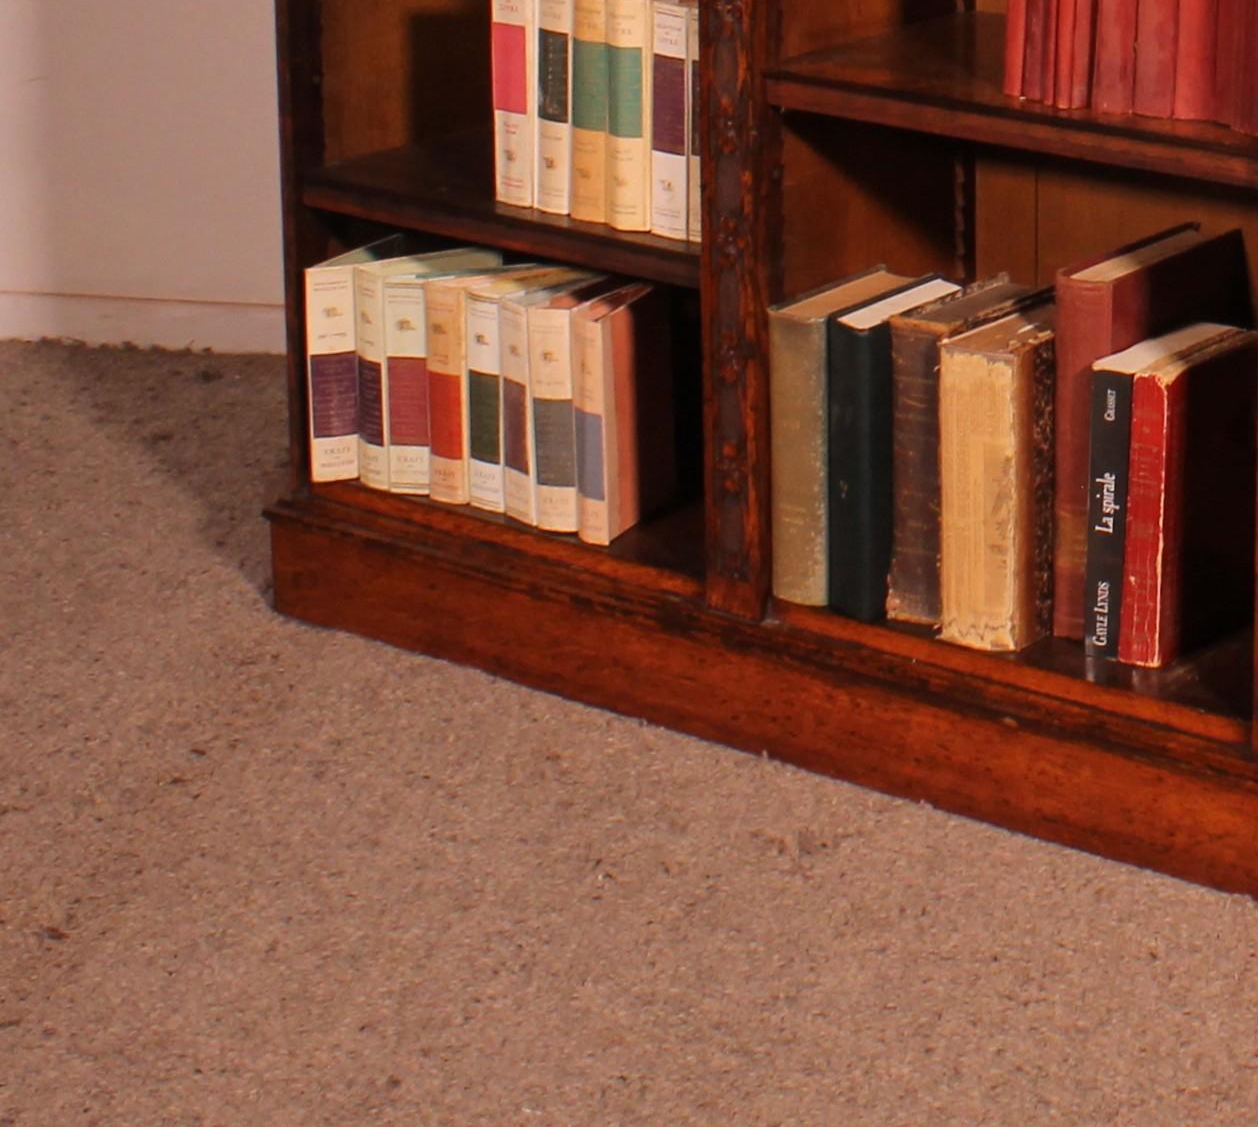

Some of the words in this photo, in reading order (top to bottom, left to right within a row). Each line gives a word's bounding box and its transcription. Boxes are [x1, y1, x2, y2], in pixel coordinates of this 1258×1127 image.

[1096, 471, 1120, 515] spirale
[1095, 516, 1114, 534] La
[1093, 581, 1111, 614] LYNDS
